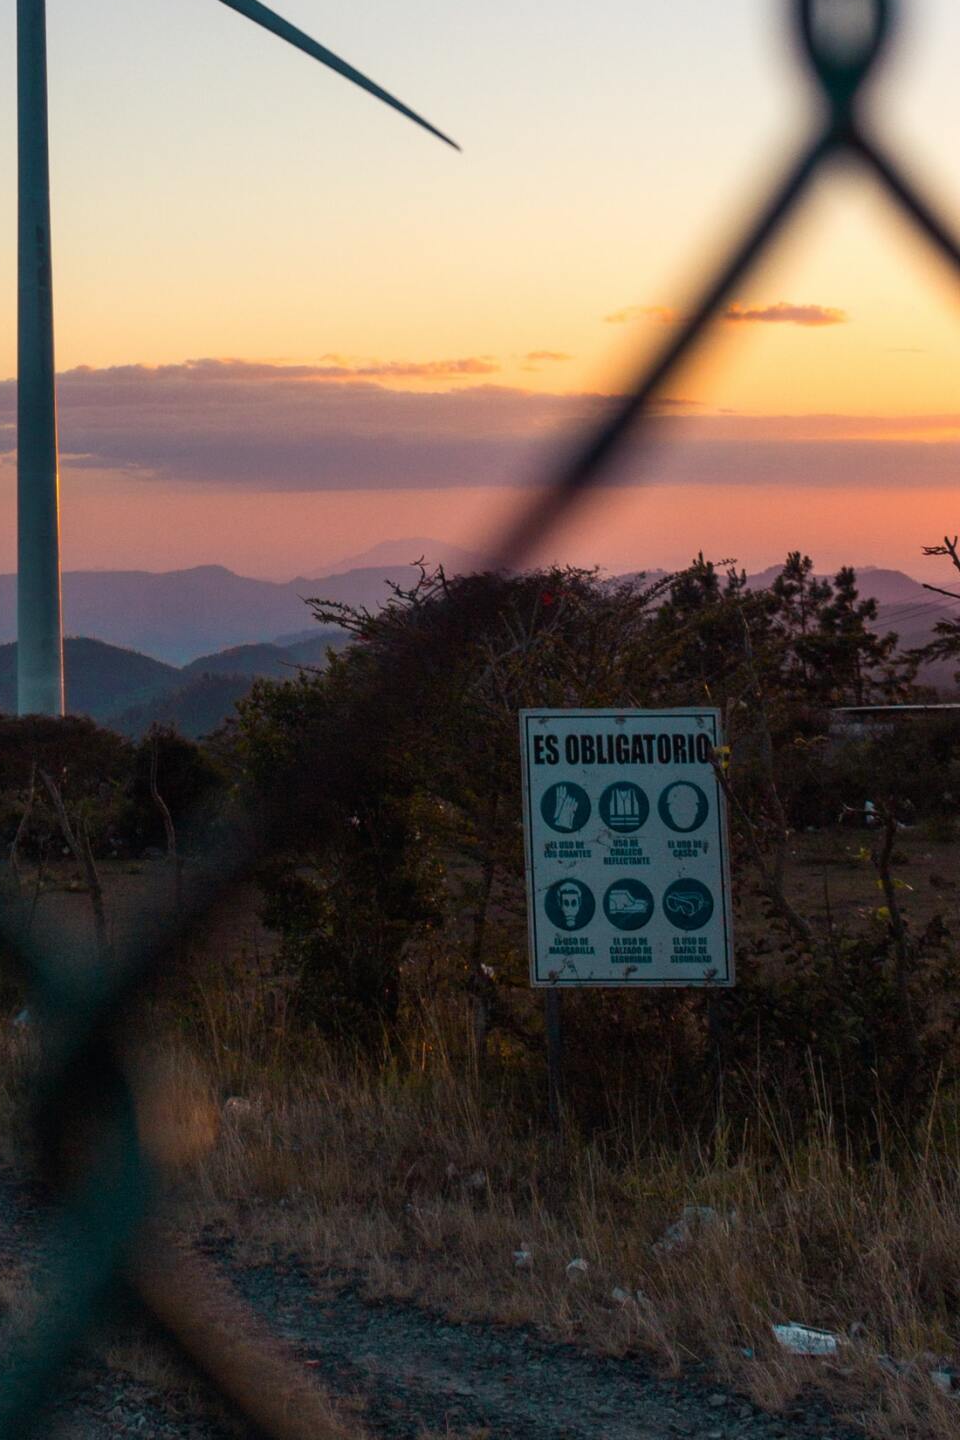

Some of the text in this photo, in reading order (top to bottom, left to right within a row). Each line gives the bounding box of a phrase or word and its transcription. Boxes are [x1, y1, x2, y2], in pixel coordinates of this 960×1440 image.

[533, 733, 711, 765] ES OBLIGATORIO
[609, 946, 641, 954] CALZADO
